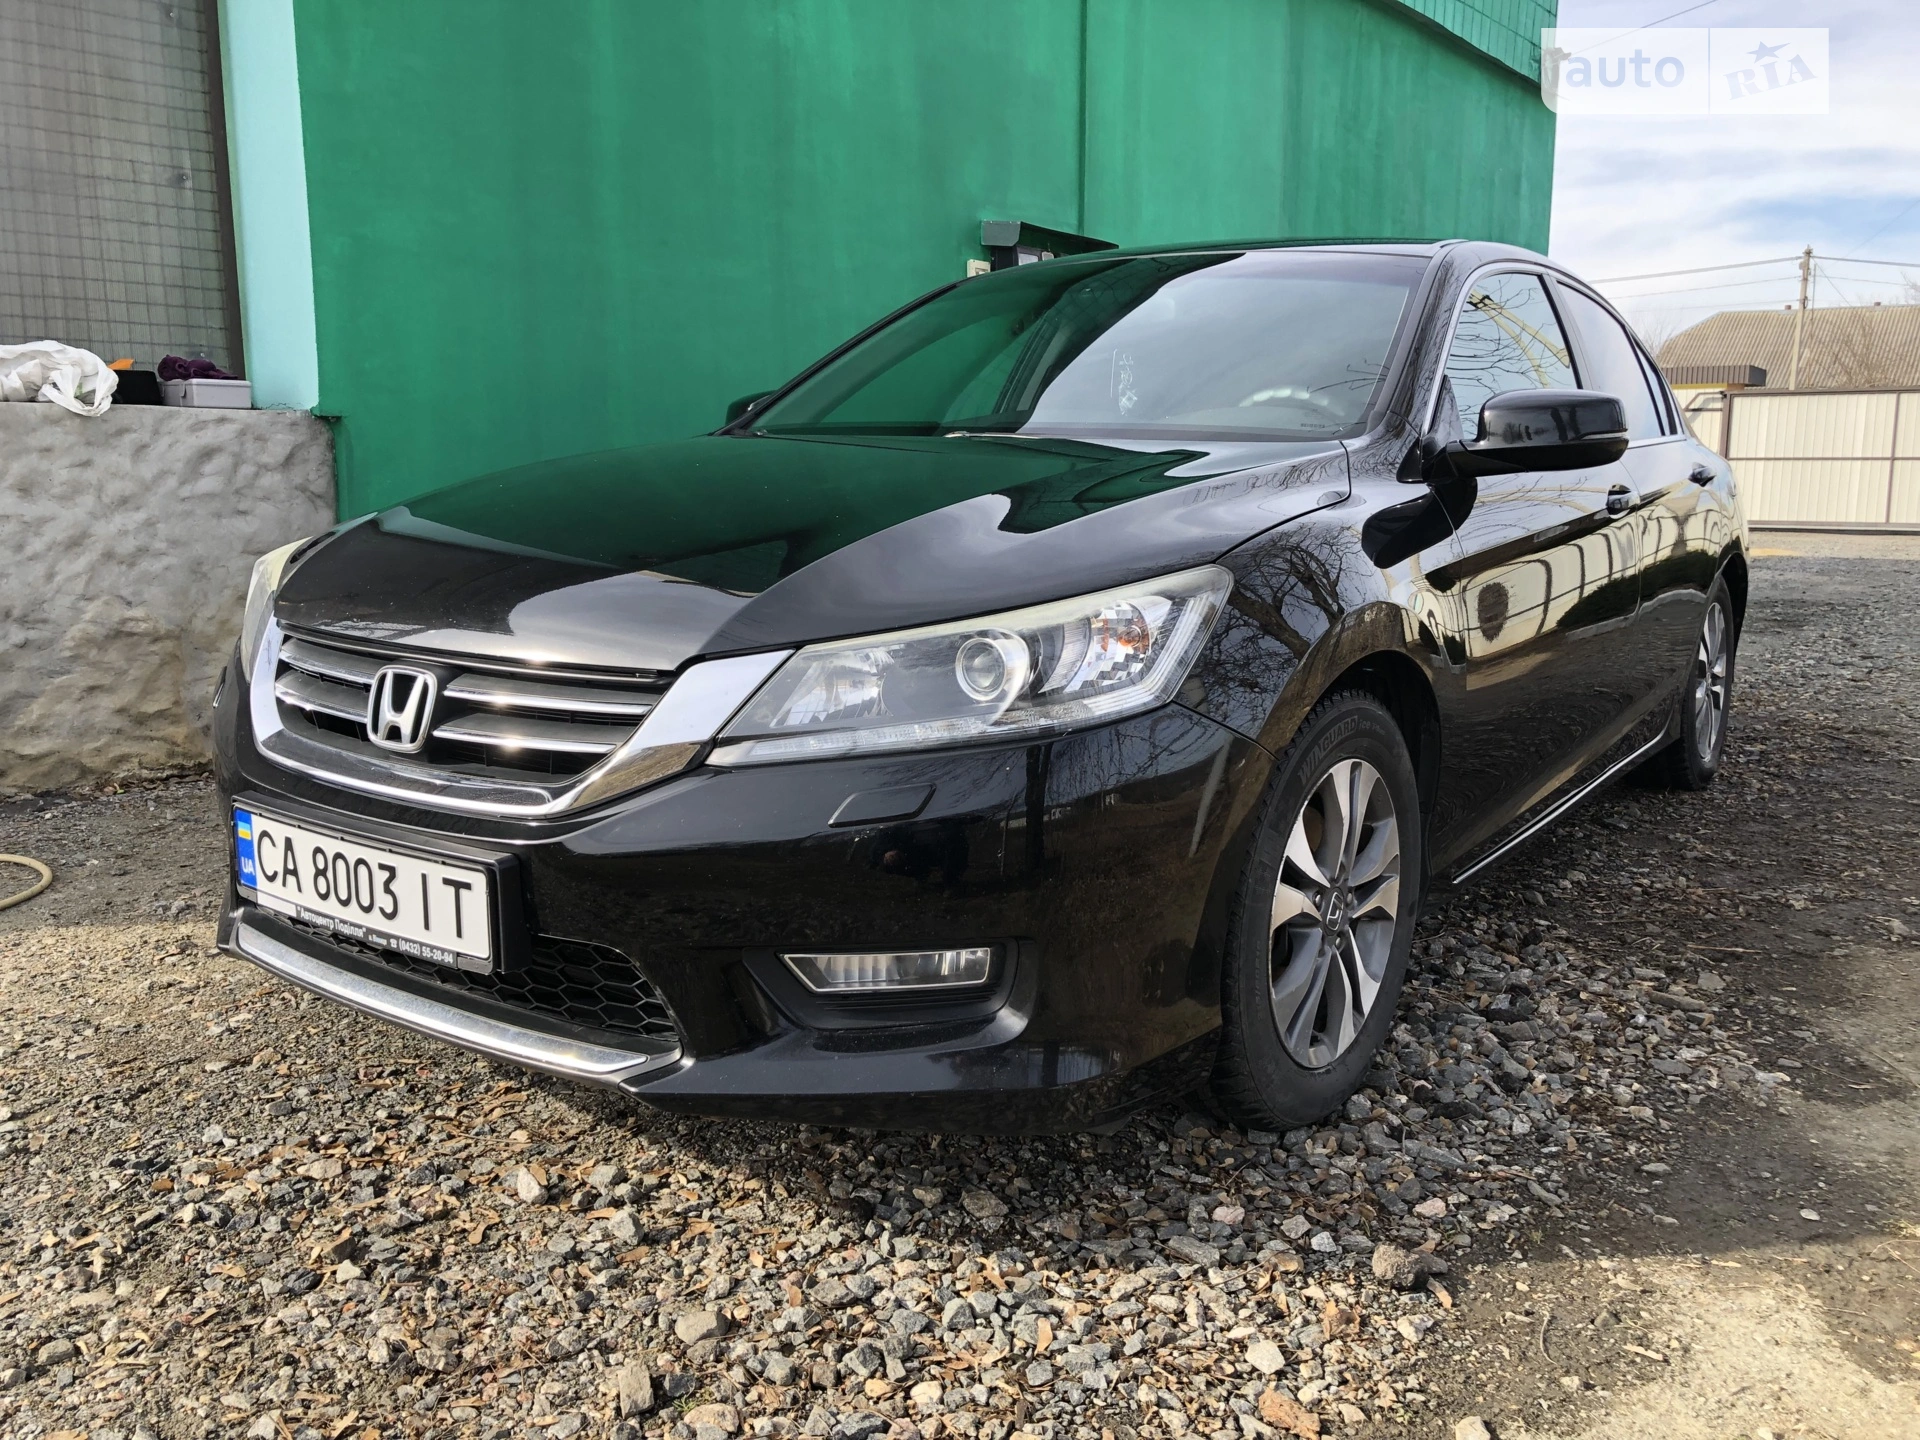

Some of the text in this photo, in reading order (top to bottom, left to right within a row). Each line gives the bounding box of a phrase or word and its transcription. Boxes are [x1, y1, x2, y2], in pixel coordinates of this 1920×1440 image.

[241, 856, 255, 876] UA
[257, 829, 472, 939] CA 8003 IT
[399, 938, 421, 956] (0432)
[422, 945, 454, 964] 55-20-94
